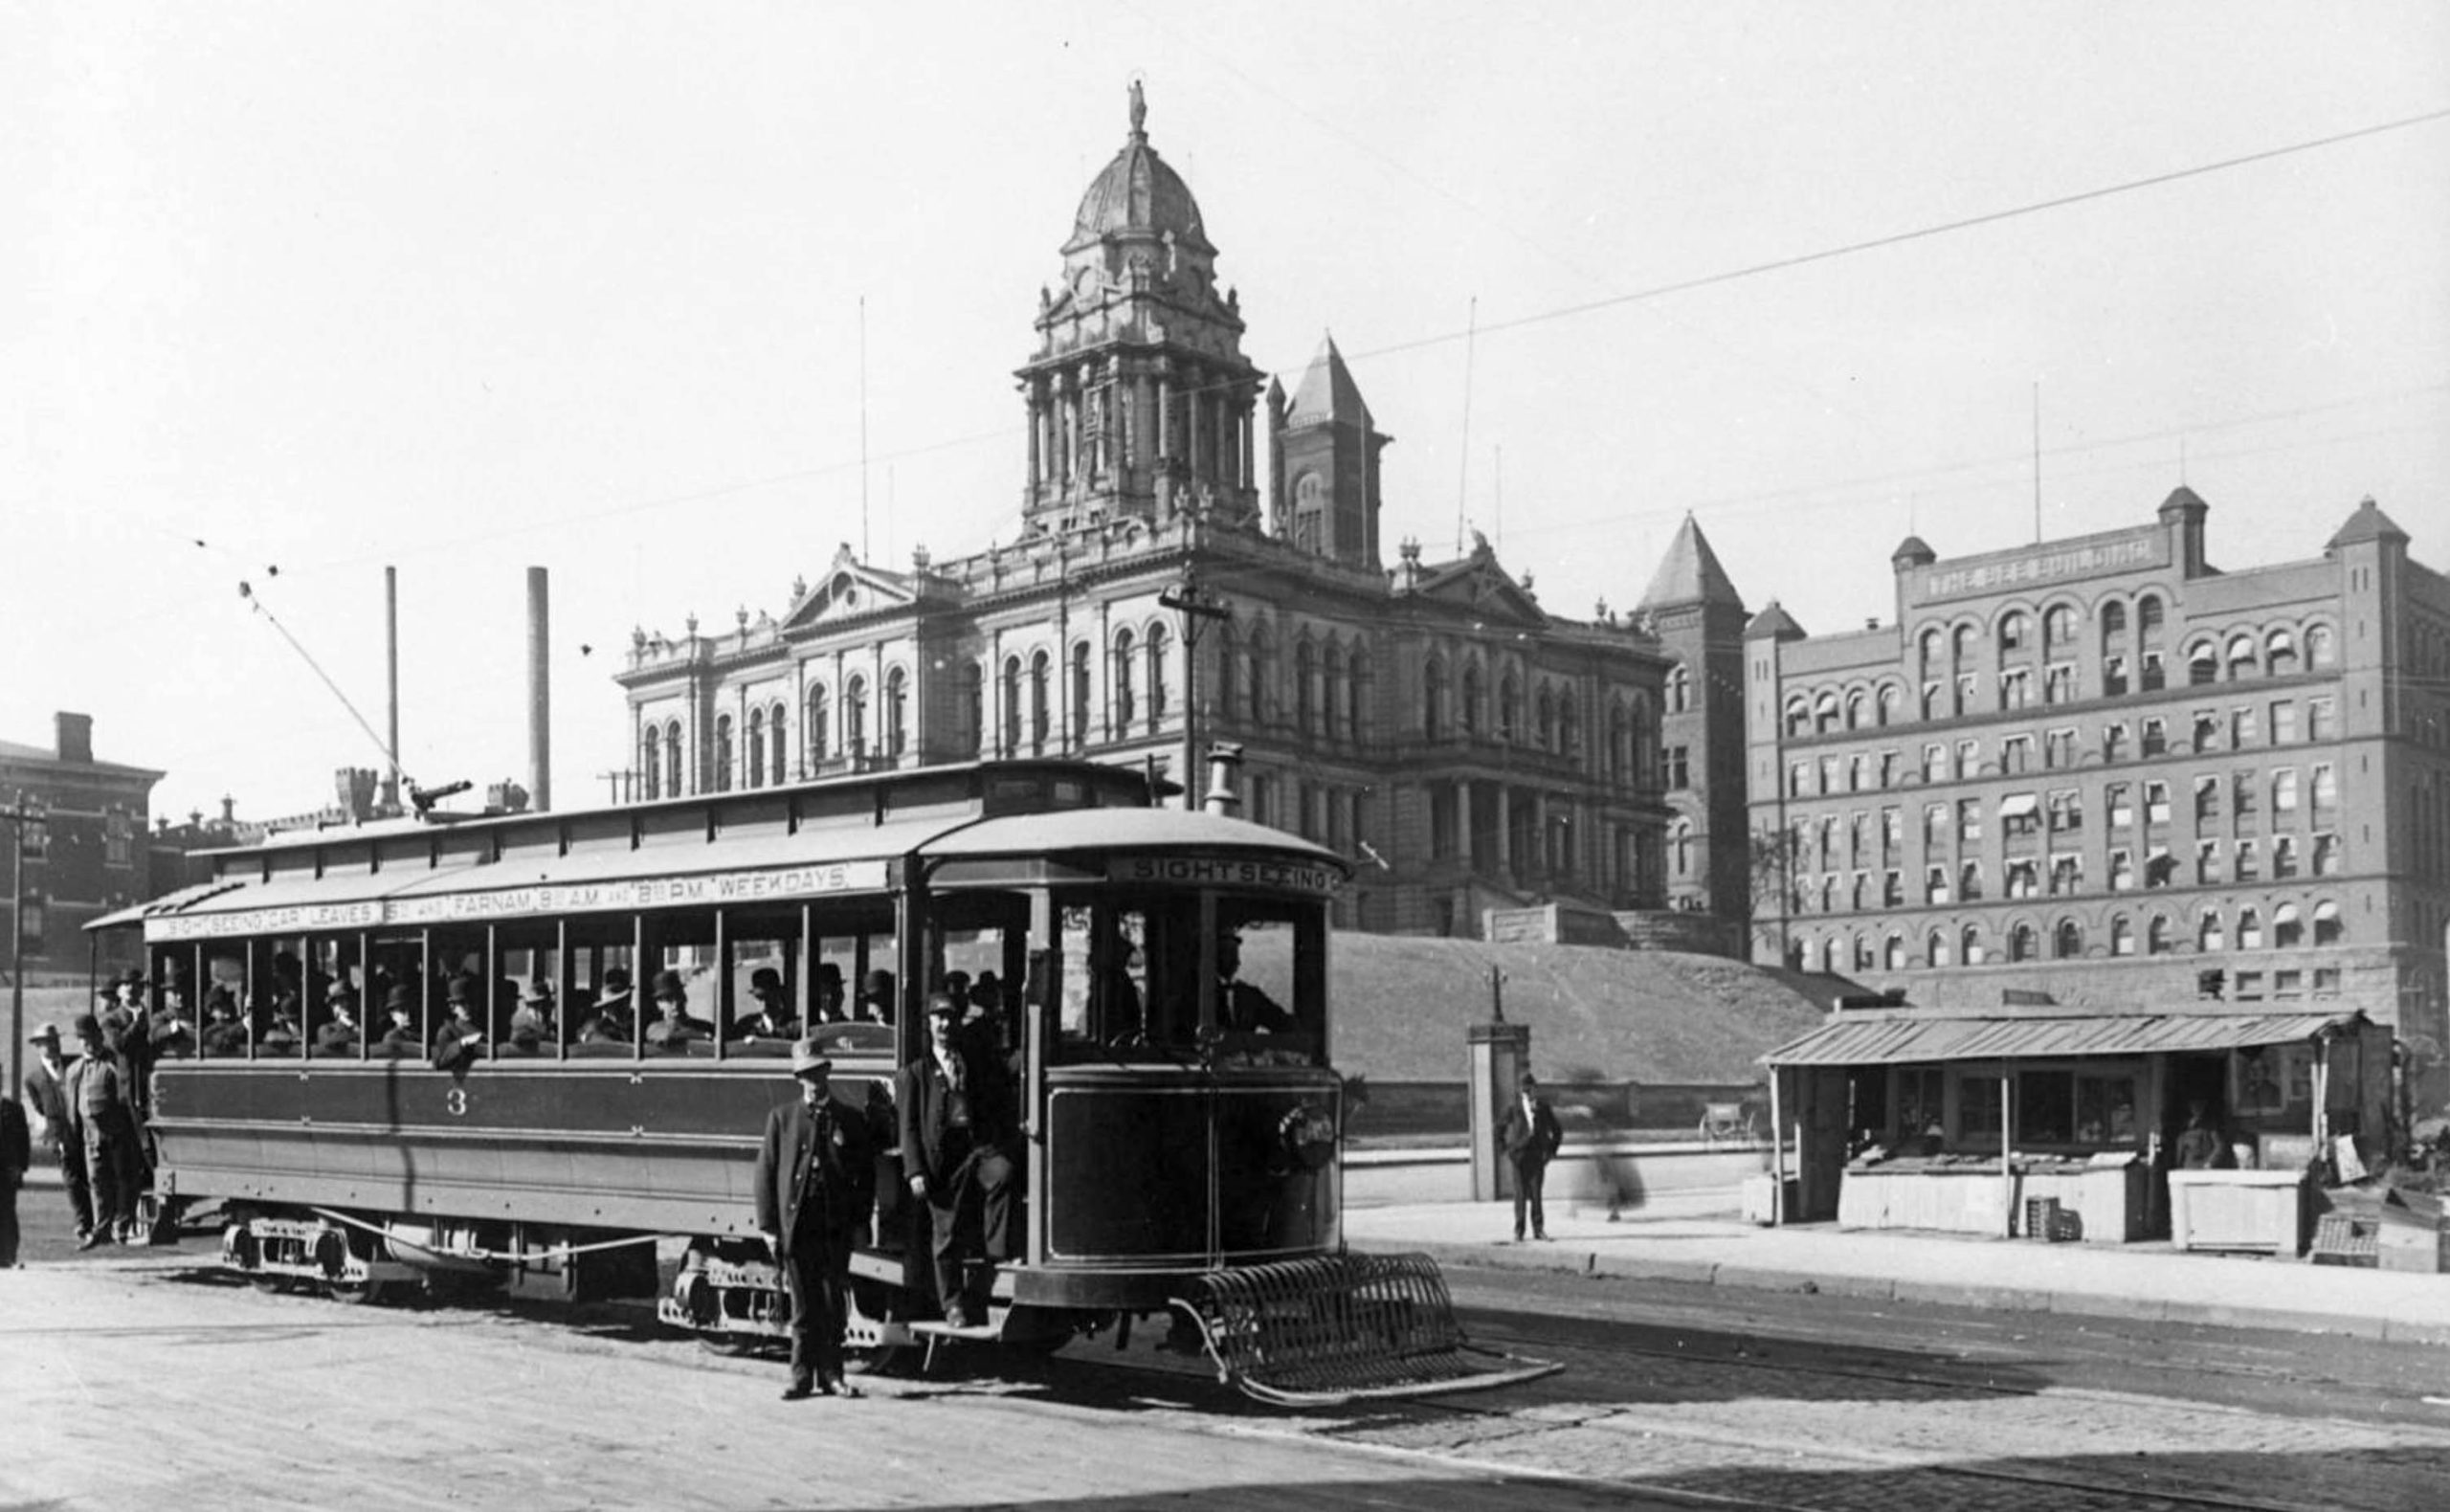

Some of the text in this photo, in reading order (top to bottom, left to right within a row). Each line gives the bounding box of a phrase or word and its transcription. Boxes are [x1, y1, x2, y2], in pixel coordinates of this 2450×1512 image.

[309, 904, 371, 925] LEAVES
[455, 891, 531, 916] FARNAM
[719, 865, 844, 896] WEEKDAYS
[447, 1088, 467, 1116] 3
